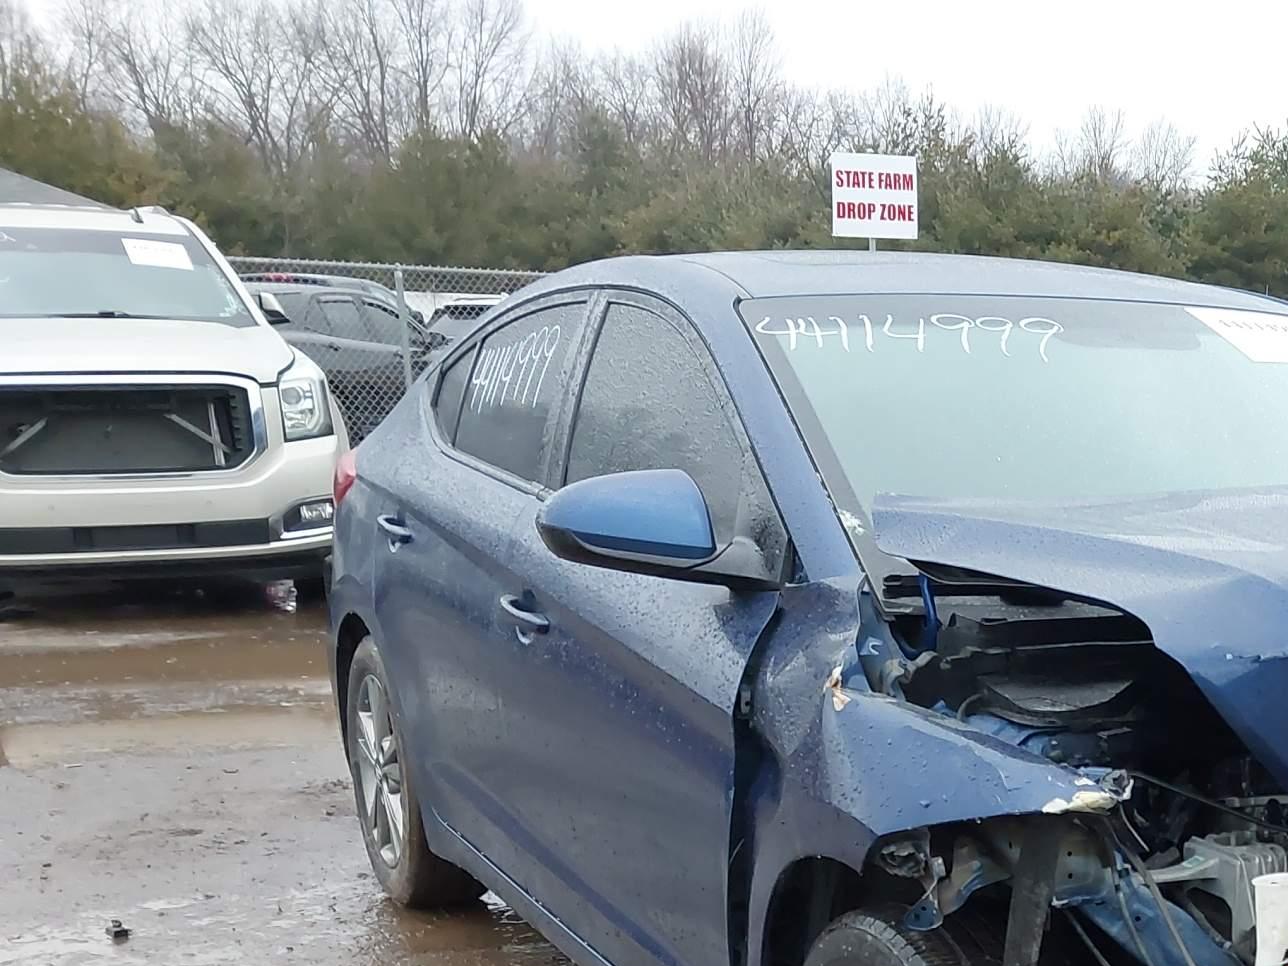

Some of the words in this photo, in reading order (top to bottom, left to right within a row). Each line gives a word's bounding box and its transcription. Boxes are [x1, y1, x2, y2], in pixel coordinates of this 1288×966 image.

[835, 169, 875, 189] STATE
[878, 172, 914, 191] FARM
[836, 201, 876, 220] DROP
[879, 203, 915, 222] ZONE
[755, 313, 1064, 363] 44114999
